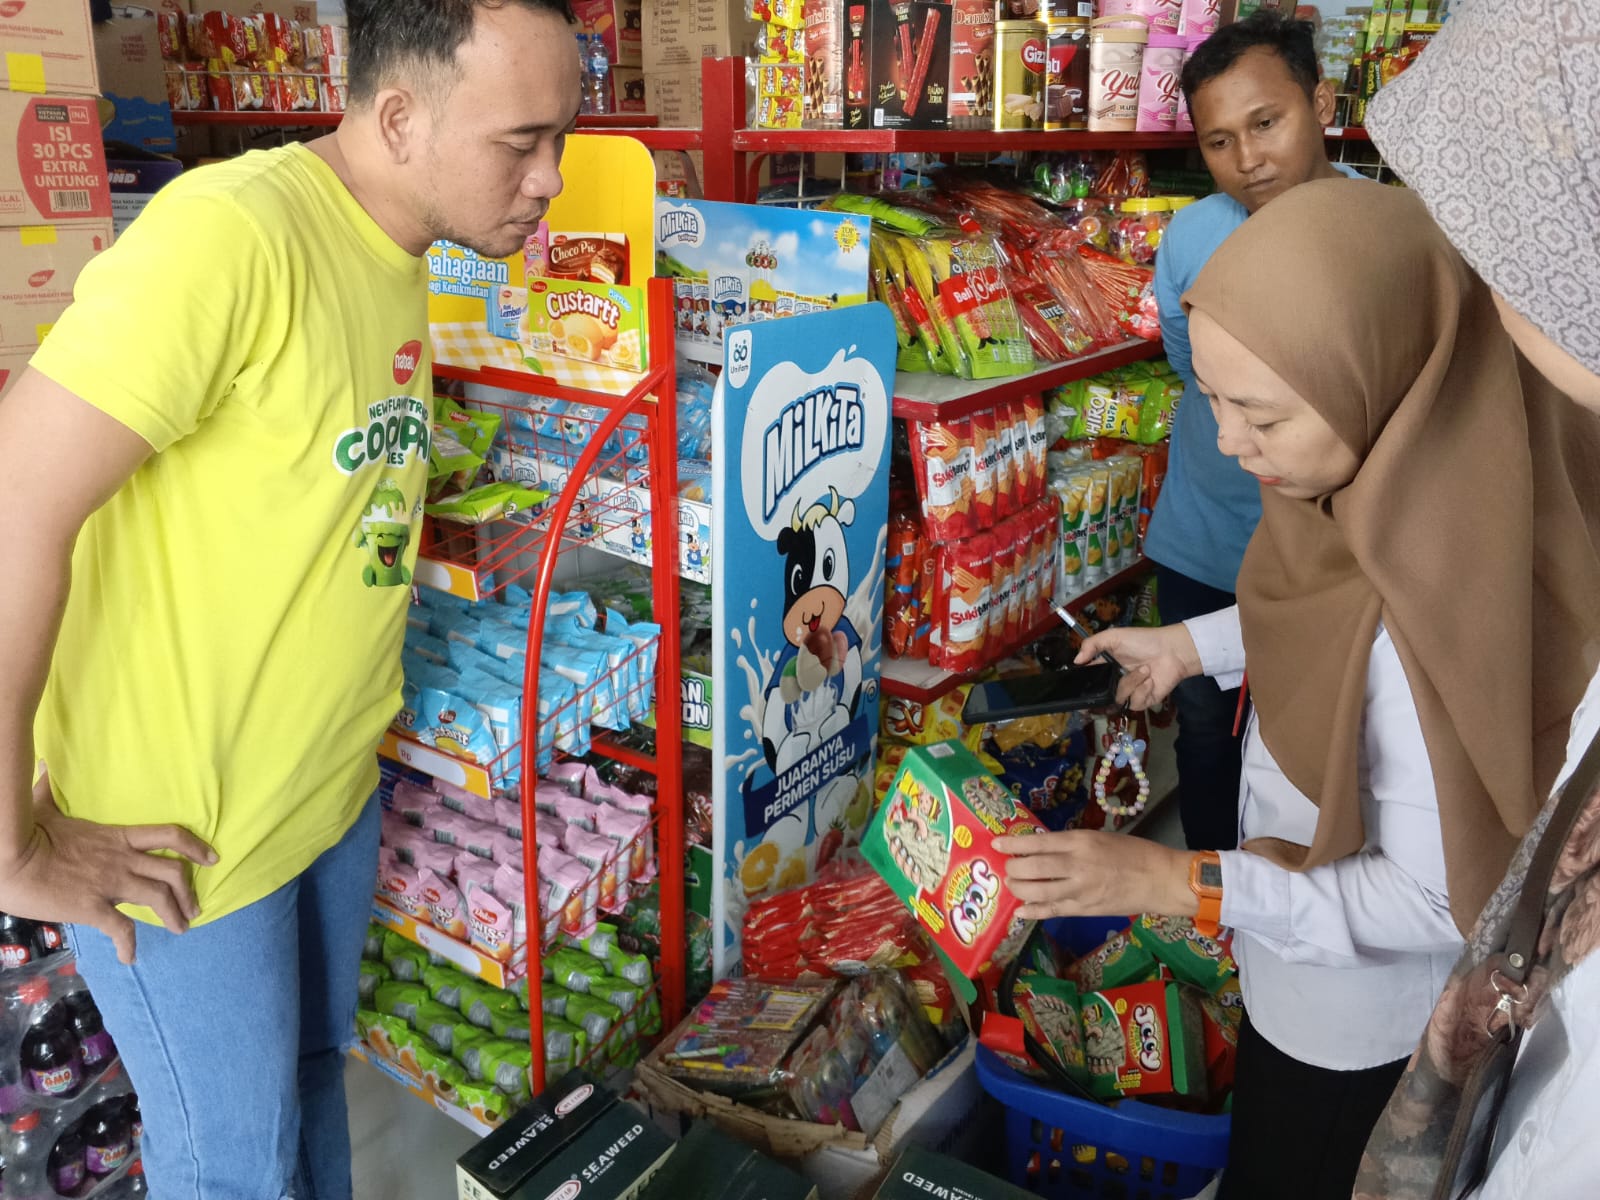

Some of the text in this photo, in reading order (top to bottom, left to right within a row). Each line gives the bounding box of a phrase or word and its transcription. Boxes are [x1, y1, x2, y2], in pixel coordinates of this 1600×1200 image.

[48, 126, 72, 142] ISI
[33, 143, 93, 159] 30 PCS
[42, 160, 88, 173] EXTRA
[34, 174, 100, 187] UNTUNG!
[551, 240, 597, 264] Choco Pie
[442, 281, 490, 298] Kenikmatan
[546, 289, 620, 329] Custartt
[951, 599, 991, 626] Sukitar
[775, 735, 843, 798] JUARANYA
[764, 744, 855, 824] PERMEN SUSU
[488, 1116, 554, 1170] SEAWEED
[582, 1124, 644, 1180] SEAWEED
